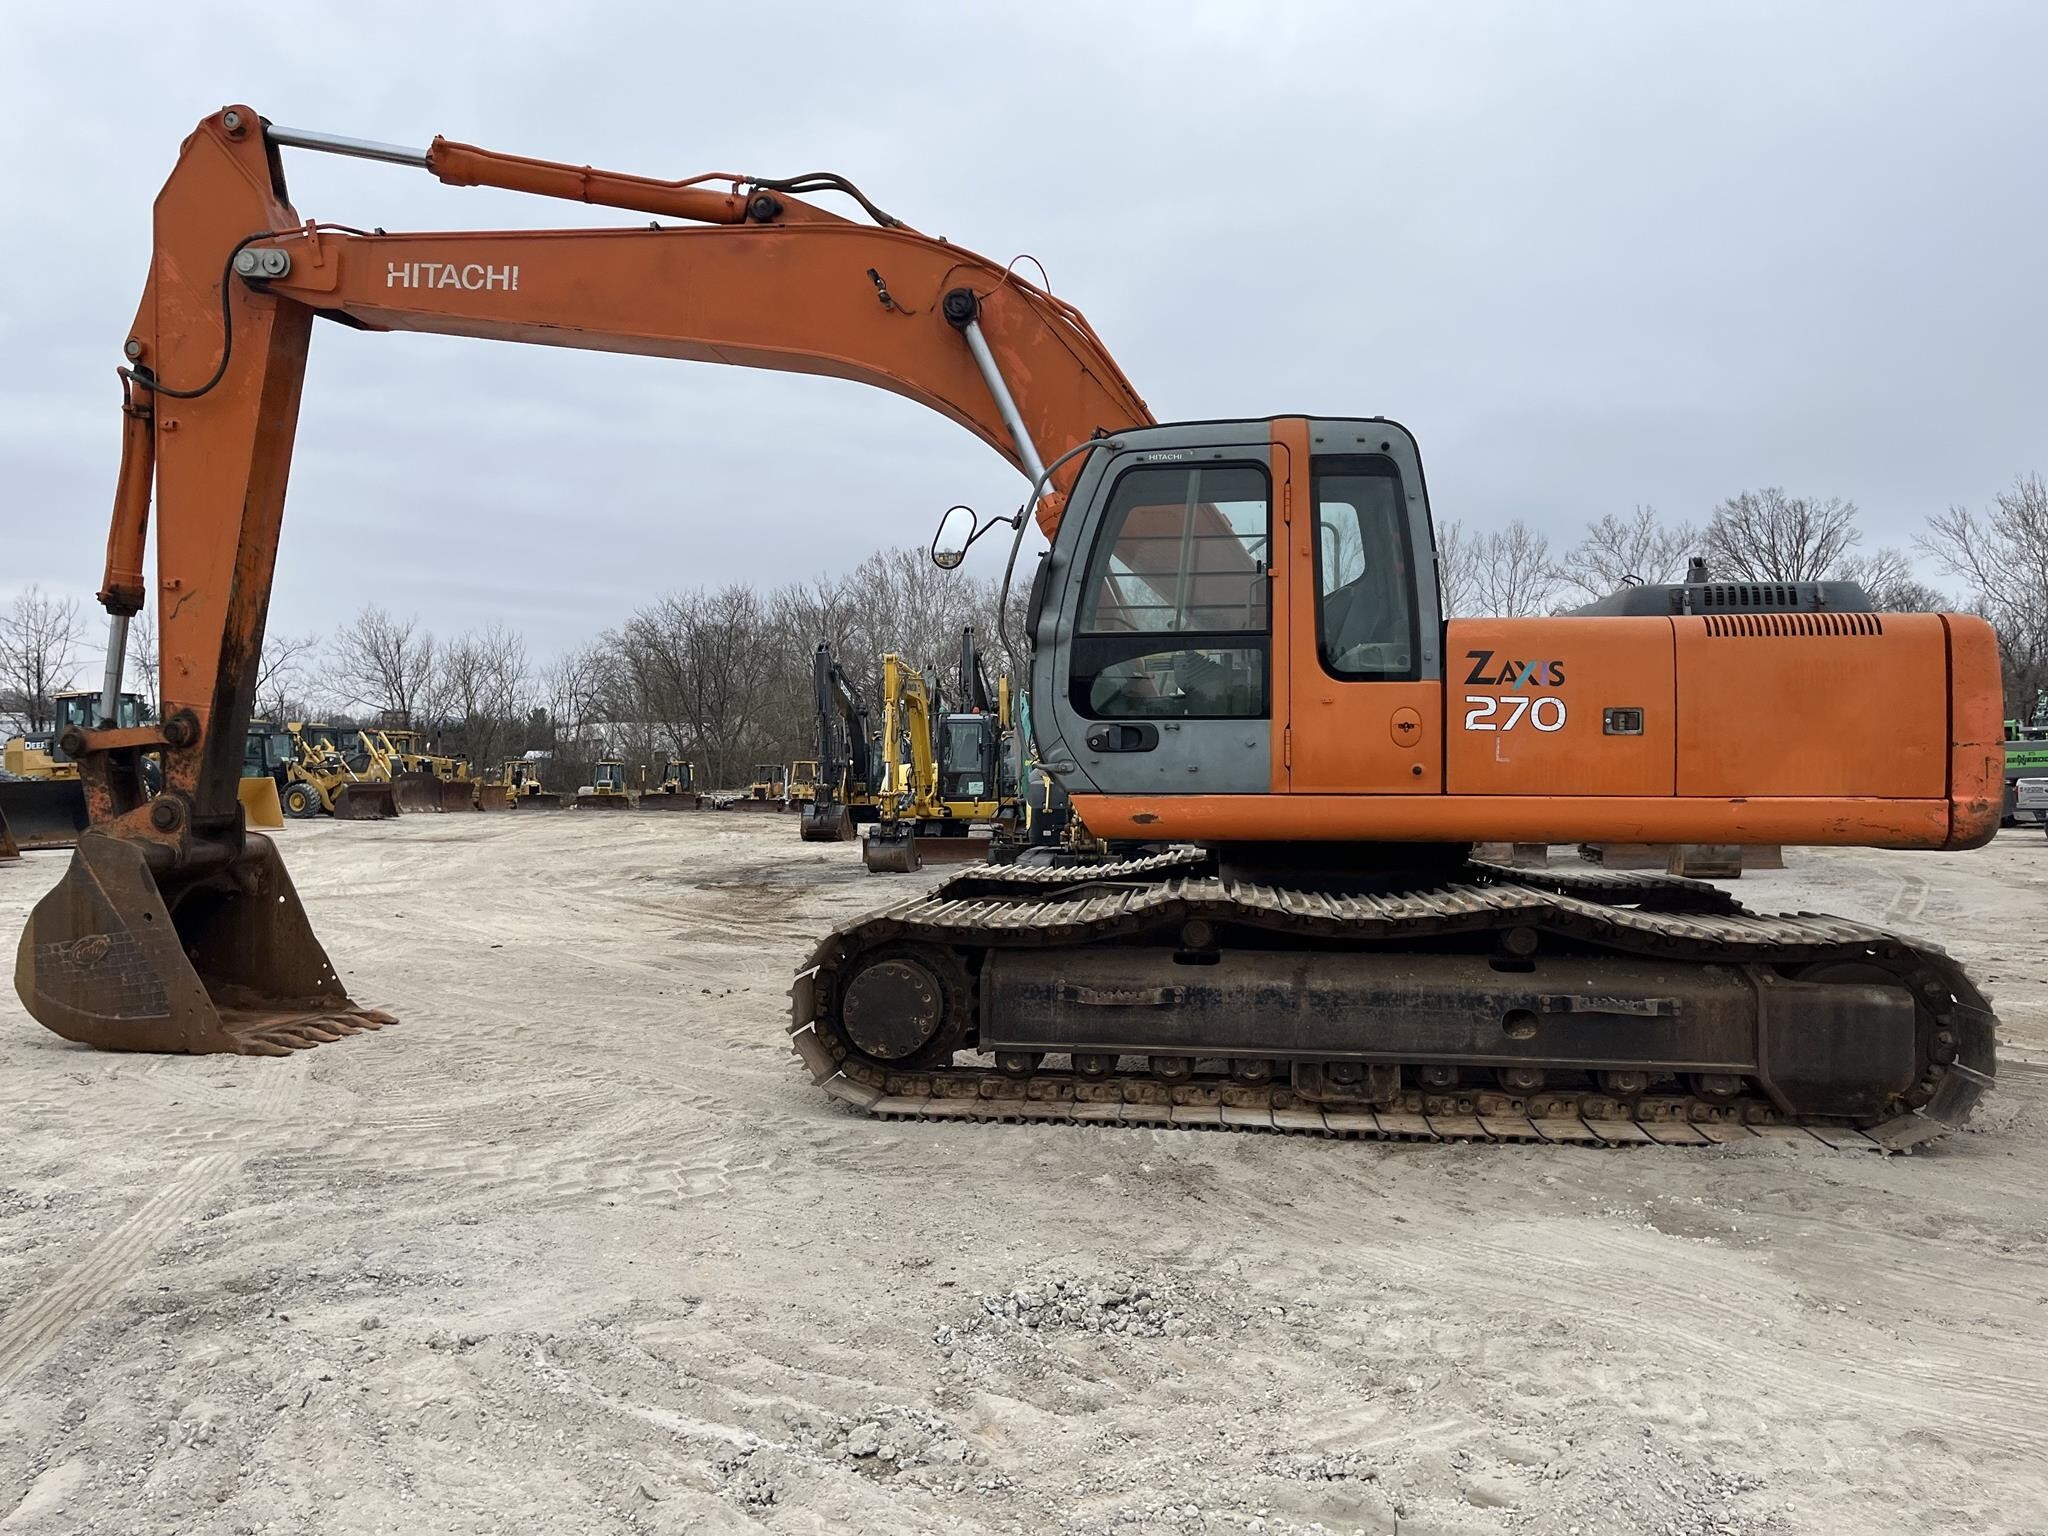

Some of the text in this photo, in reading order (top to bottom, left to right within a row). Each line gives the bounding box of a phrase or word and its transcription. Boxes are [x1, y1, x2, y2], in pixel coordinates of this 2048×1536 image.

[387, 262, 519, 291] HITACHI
[1148, 453, 1182, 461] HITACHI
[1464, 650, 1566, 691] ZAXIS
[1465, 695, 1568, 732] 270
[24, 741, 46, 750] DEER
